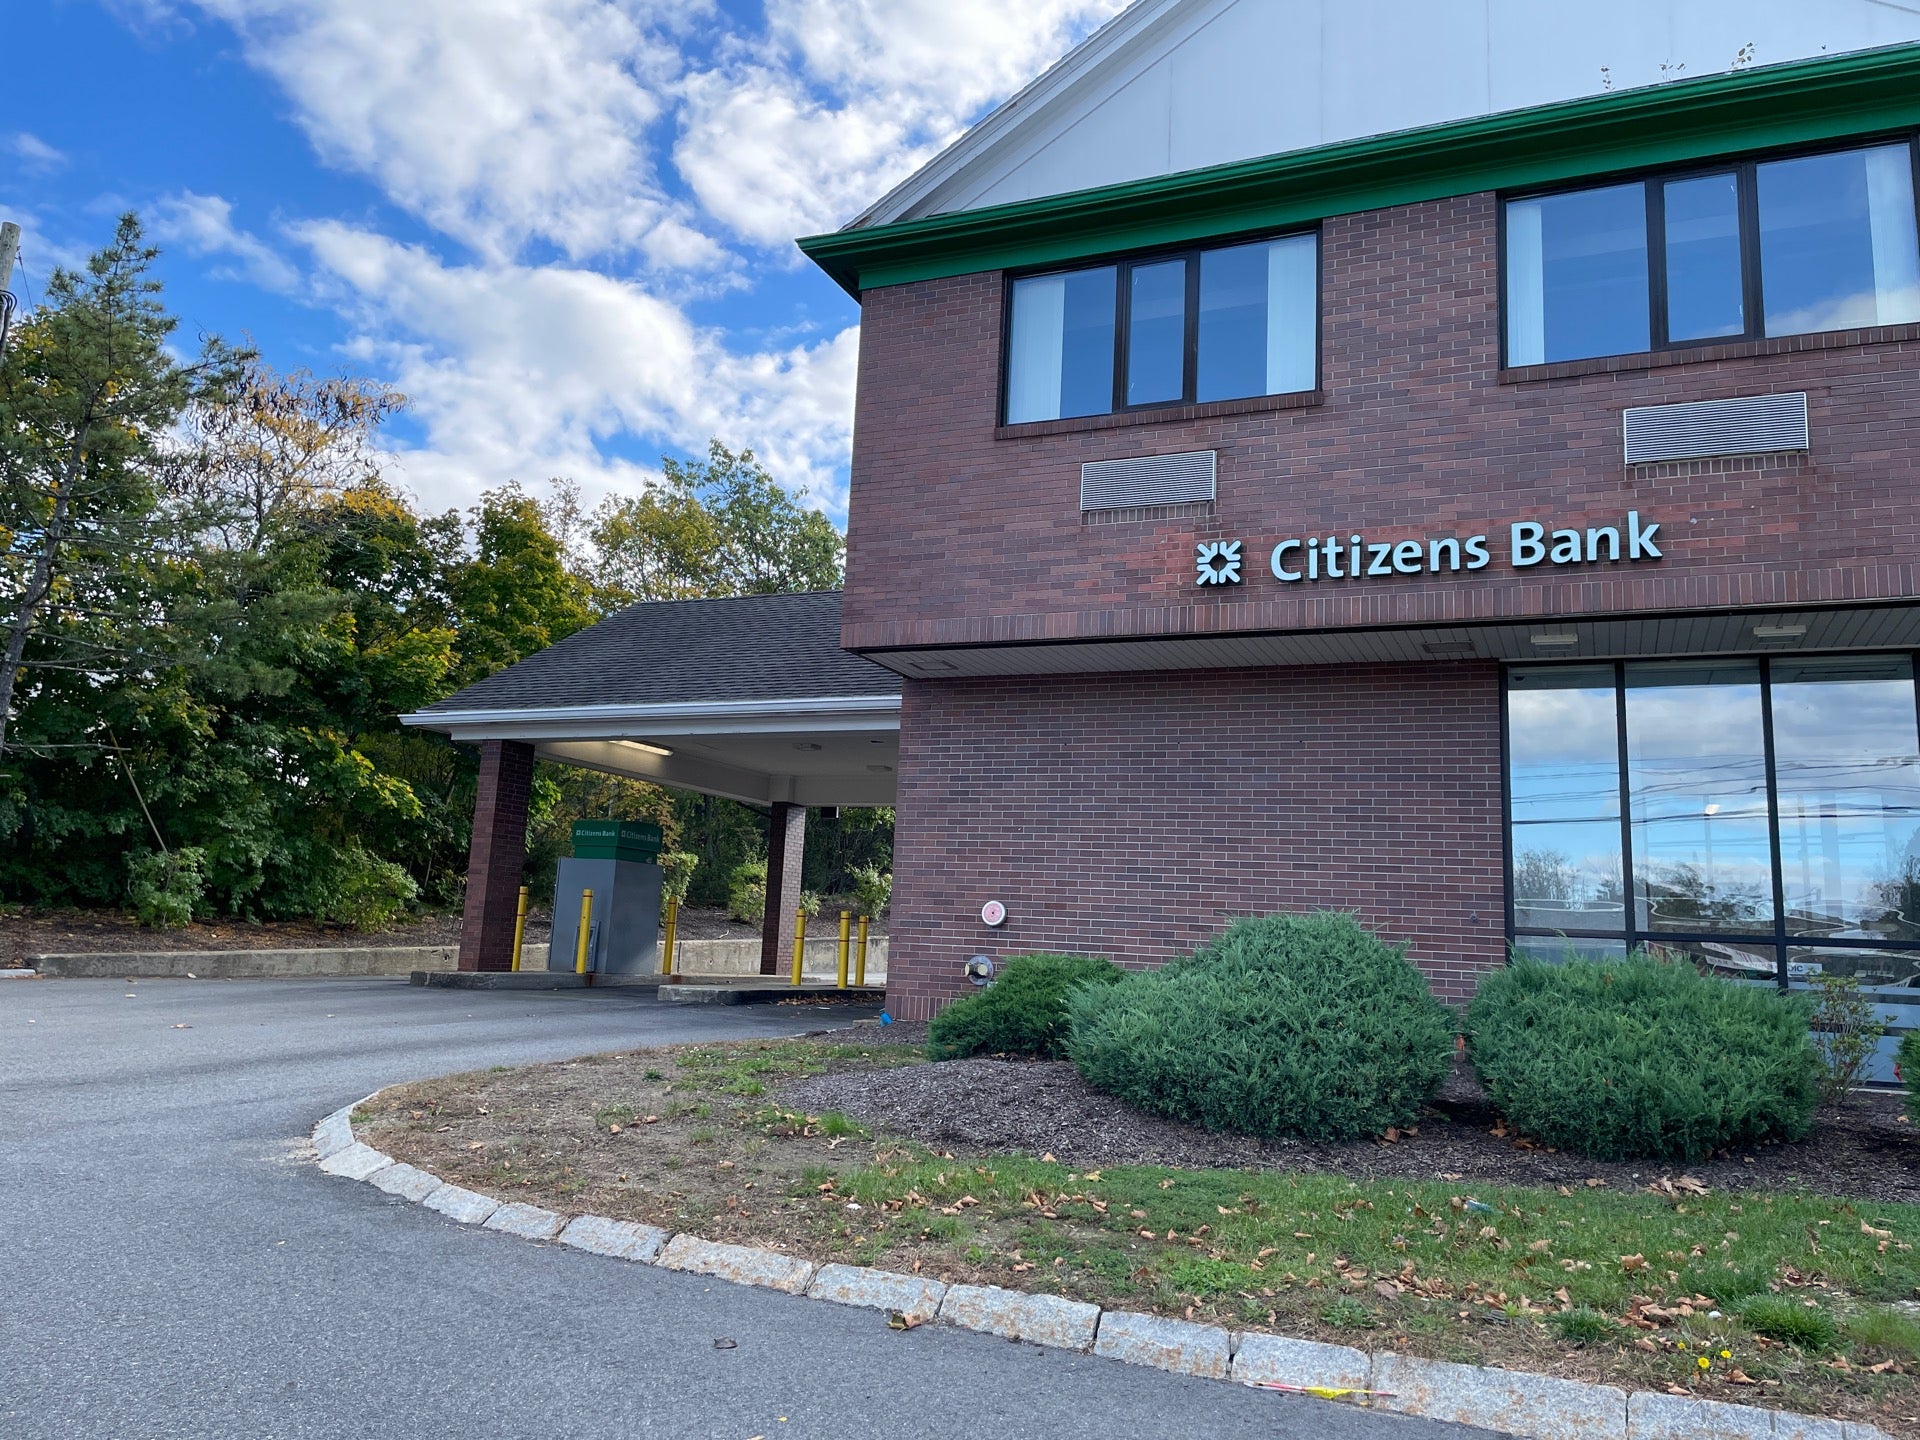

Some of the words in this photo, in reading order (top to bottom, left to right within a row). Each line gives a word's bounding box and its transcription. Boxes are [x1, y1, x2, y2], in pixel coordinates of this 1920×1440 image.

[1270, 534, 1490, 582] Citizens
[1510, 510, 1664, 568] Bank
[627, 831, 646, 840] Citizens
[647, 834, 659, 842] Bank
